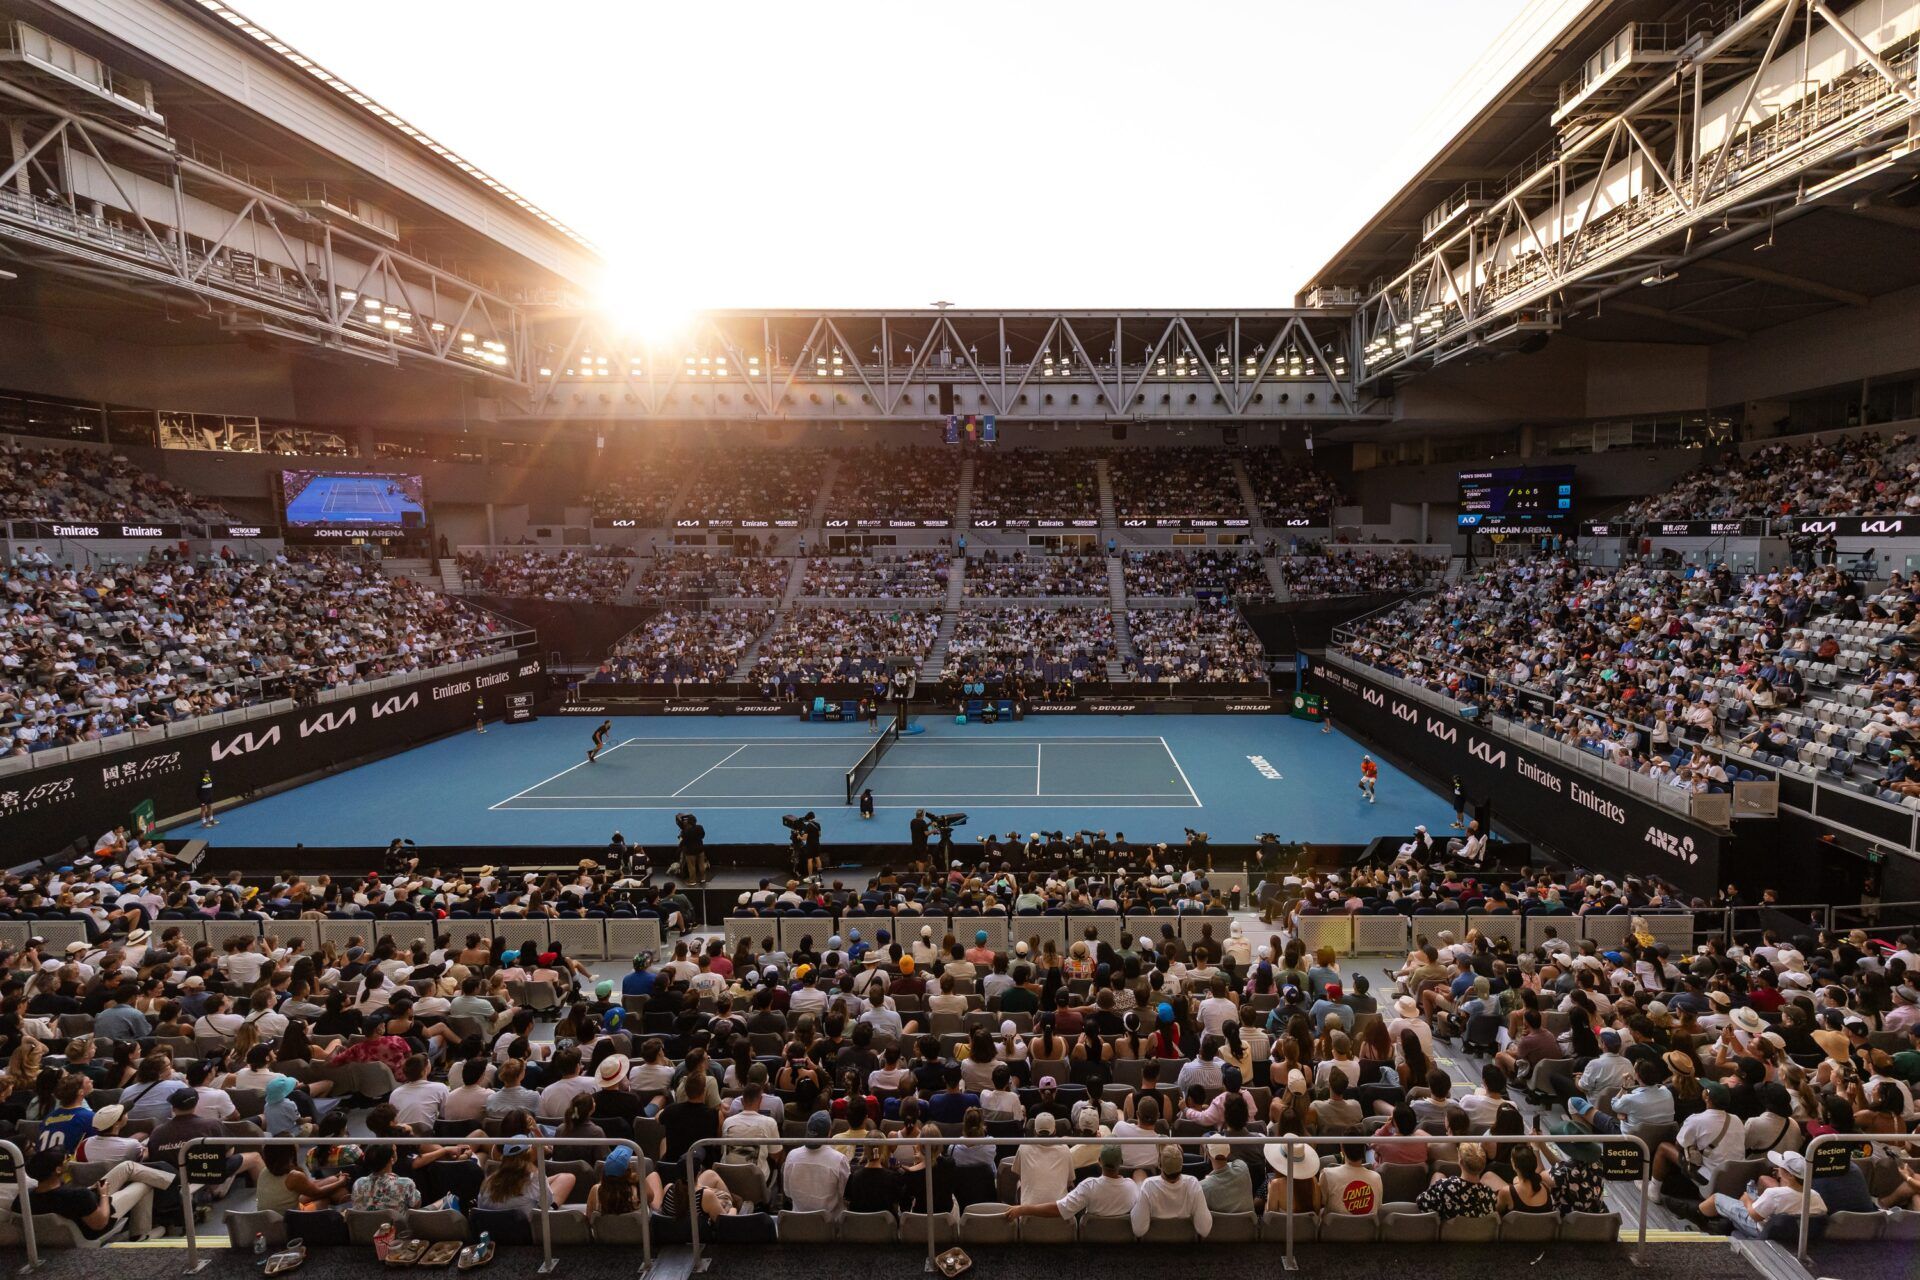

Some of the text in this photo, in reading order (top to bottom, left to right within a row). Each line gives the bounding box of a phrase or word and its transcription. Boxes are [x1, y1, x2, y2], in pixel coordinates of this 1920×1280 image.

[53, 526, 99, 536] Emirates
[123, 526, 162, 536] Emirates
[1802, 522, 1836, 533] KIA
[1861, 520, 1902, 533] KIA
[432, 681, 471, 700] Emirates
[476, 671, 509, 689] Emirates
[372, 691, 419, 719] KIA
[1362, 686, 1384, 708] KIA
[300, 707, 356, 738] KIA
[1392, 701, 1418, 724] KIA
[1427, 717, 1456, 744] KIA
[211, 726, 280, 762] KIA
[1468, 737, 1506, 769] KIA
[159, 764, 182, 775] 1573
[1517, 756, 1561, 793] Emirates
[48, 792, 76, 804] 1573
[1570, 781, 1625, 825] Emirates
[1644, 826, 1679, 857] ANZ
[40, 1131, 65, 1152] 10
[1344, 1185, 1371, 1200] SANTA
[1348, 1197, 1370, 1211] CRUZ
